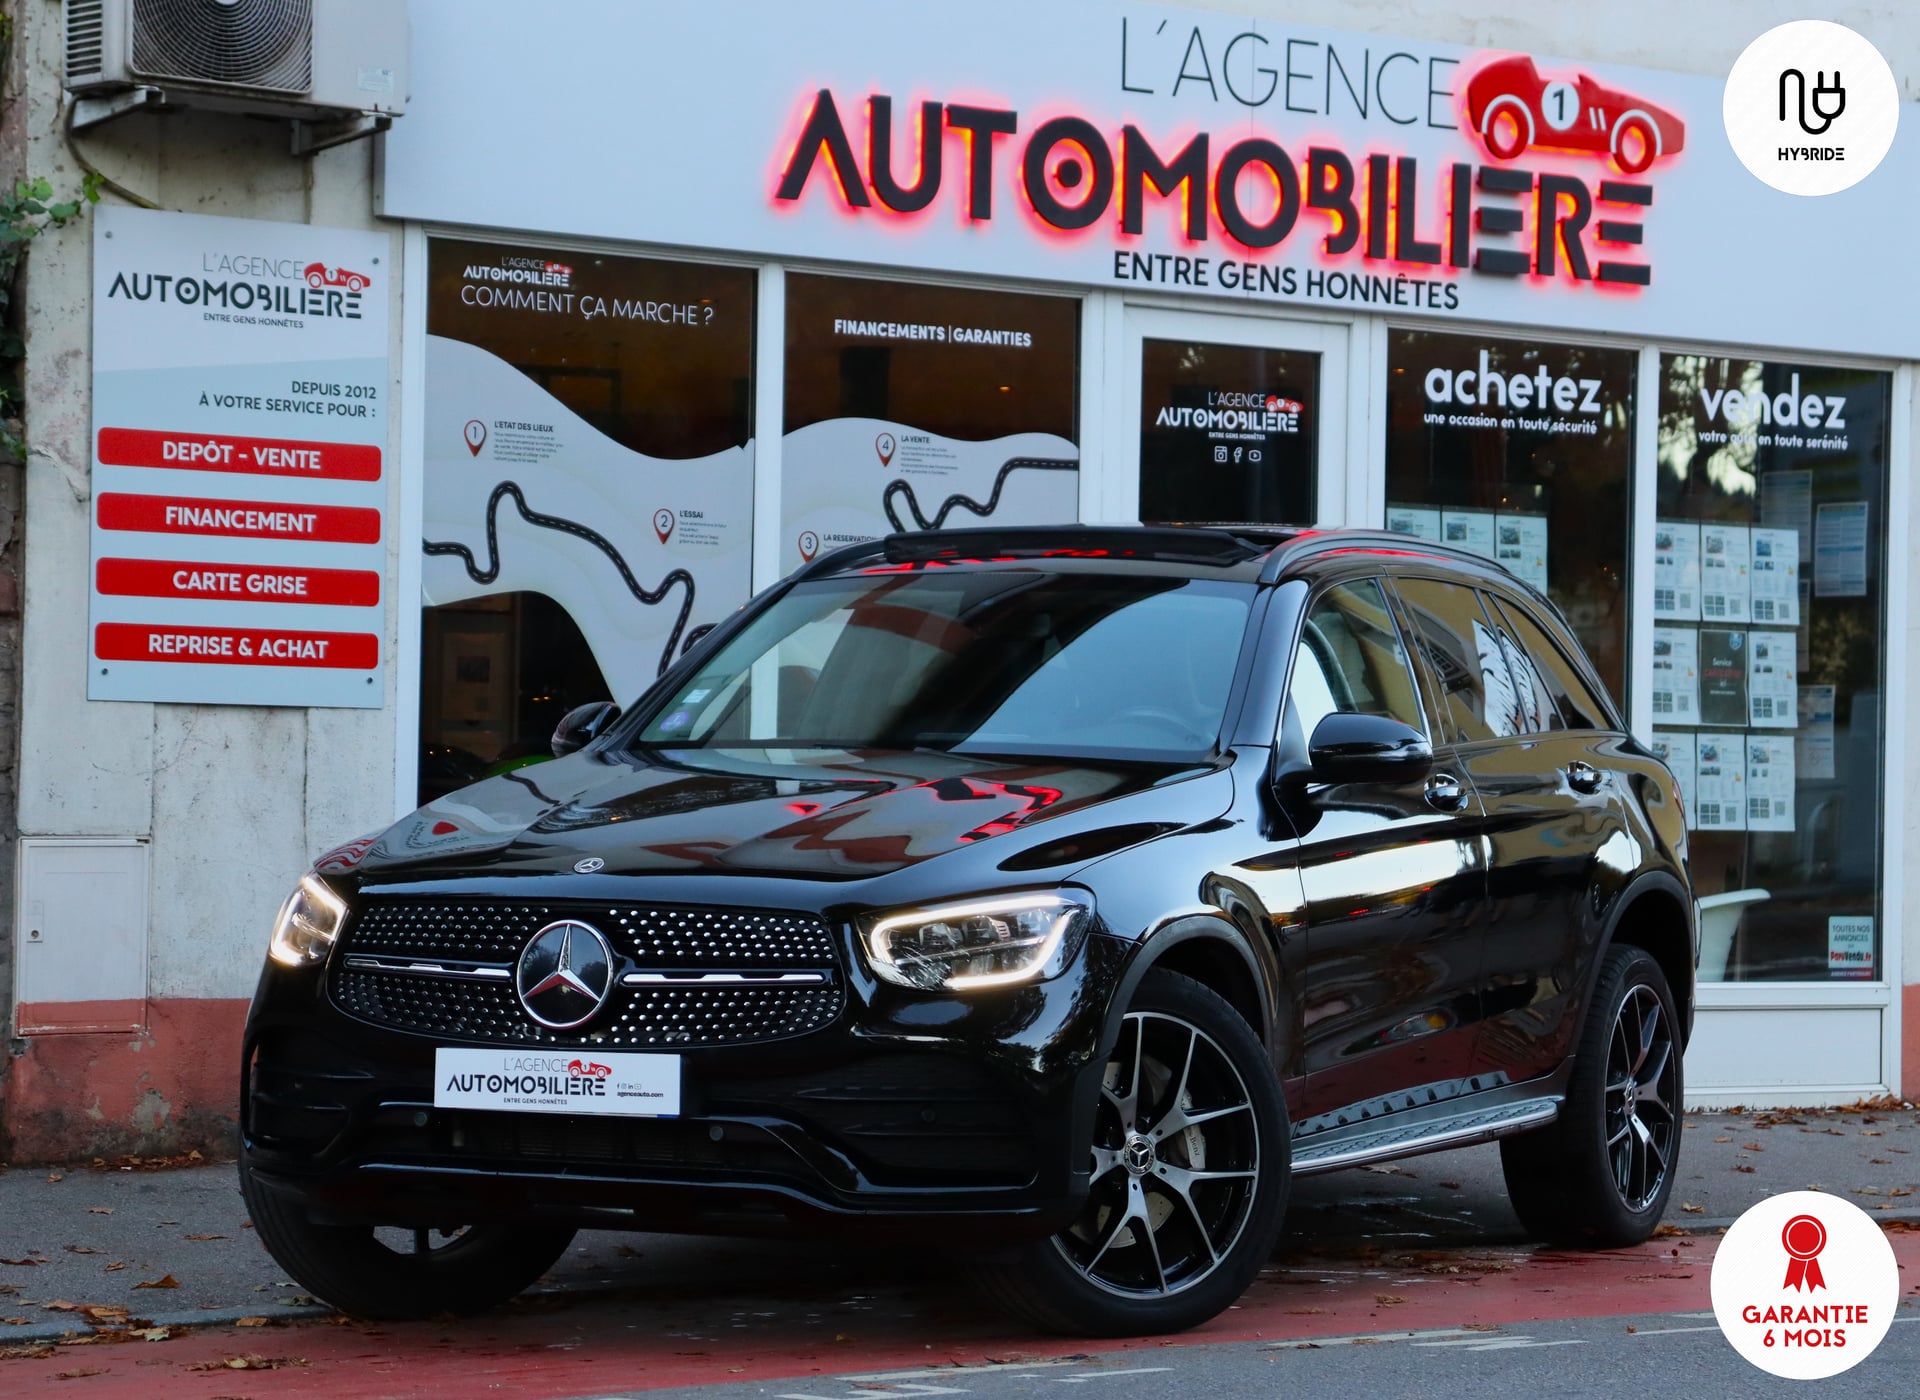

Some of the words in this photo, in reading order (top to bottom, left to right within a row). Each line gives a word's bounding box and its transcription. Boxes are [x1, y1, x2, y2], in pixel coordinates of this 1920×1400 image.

[1121, 16, 1461, 131] L'AGENCE
[203, 252, 304, 281] L'AGENCE
[1114, 251, 1209, 286] ENTRE
[1217, 261, 1298, 295] GENS
[1307, 271, 1460, 310] HONNÊTES
[461, 285, 576, 314] COMMENT
[579, 295, 608, 321] ÇA
[612, 298, 698, 326] MARCHE
[703, 306, 714, 326] ?
[203, 313, 231, 323] ENTRE
[233, 315, 257, 325] GENS
[258, 317, 304, 329] HONNÊTES
[834, 318, 945, 341] FINANCEMENTS
[953, 327, 1032, 347] GARANTIES
[291, 380, 341, 397] DEPUIS
[345, 385, 377, 400] 2012
[1424, 349, 1602, 413] achetez
[199, 391, 209, 406] À
[212, 395, 262, 411] VOTRE
[265, 398, 324, 415] SERVICE
[327, 402, 367, 418] POUR
[1208, 391, 1266, 409] L'AGENCE
[1701, 372, 1847, 430] vendez
[517, 422, 532, 431] DES
[533, 424, 554, 433] LIEUX
[1424, 413, 1445, 424] une
[1449, 412, 1498, 428] occasion
[1501, 418, 1515, 429] en
[1519, 417, 1549, 432] toute
[1552, 417, 1598, 435] sécurité
[882, 440, 889, 451] 4
[901, 434, 910, 443] LA
[910, 436, 930, 444] VENTE
[1208, 431, 1224, 439] ENTRE
[1225, 432, 1238, 440] GENS
[1699, 430, 1727, 443] votre
[1758, 435, 1771, 446] en
[1775, 434, 1803, 448] toute
[162, 440, 234, 464] DEPÔT
[252, 447, 322, 470] VENTE
[165, 505, 317, 533] FINANCEMENT
[661, 514, 668, 528] 2
[679, 509, 704, 519] L'ESSAI
[805, 536, 812, 550] 3
[823, 533, 832, 542] LA
[172, 570, 241, 593] CARTE
[246, 574, 308, 596] GRISE
[148, 633, 233, 656] REPRISE
[238, 637, 253, 657] &
[257, 638, 329, 660] ACHAT
[1832, 924, 1856, 933] TOUTES
[503, 1057, 569, 1073] L'AGENCE
